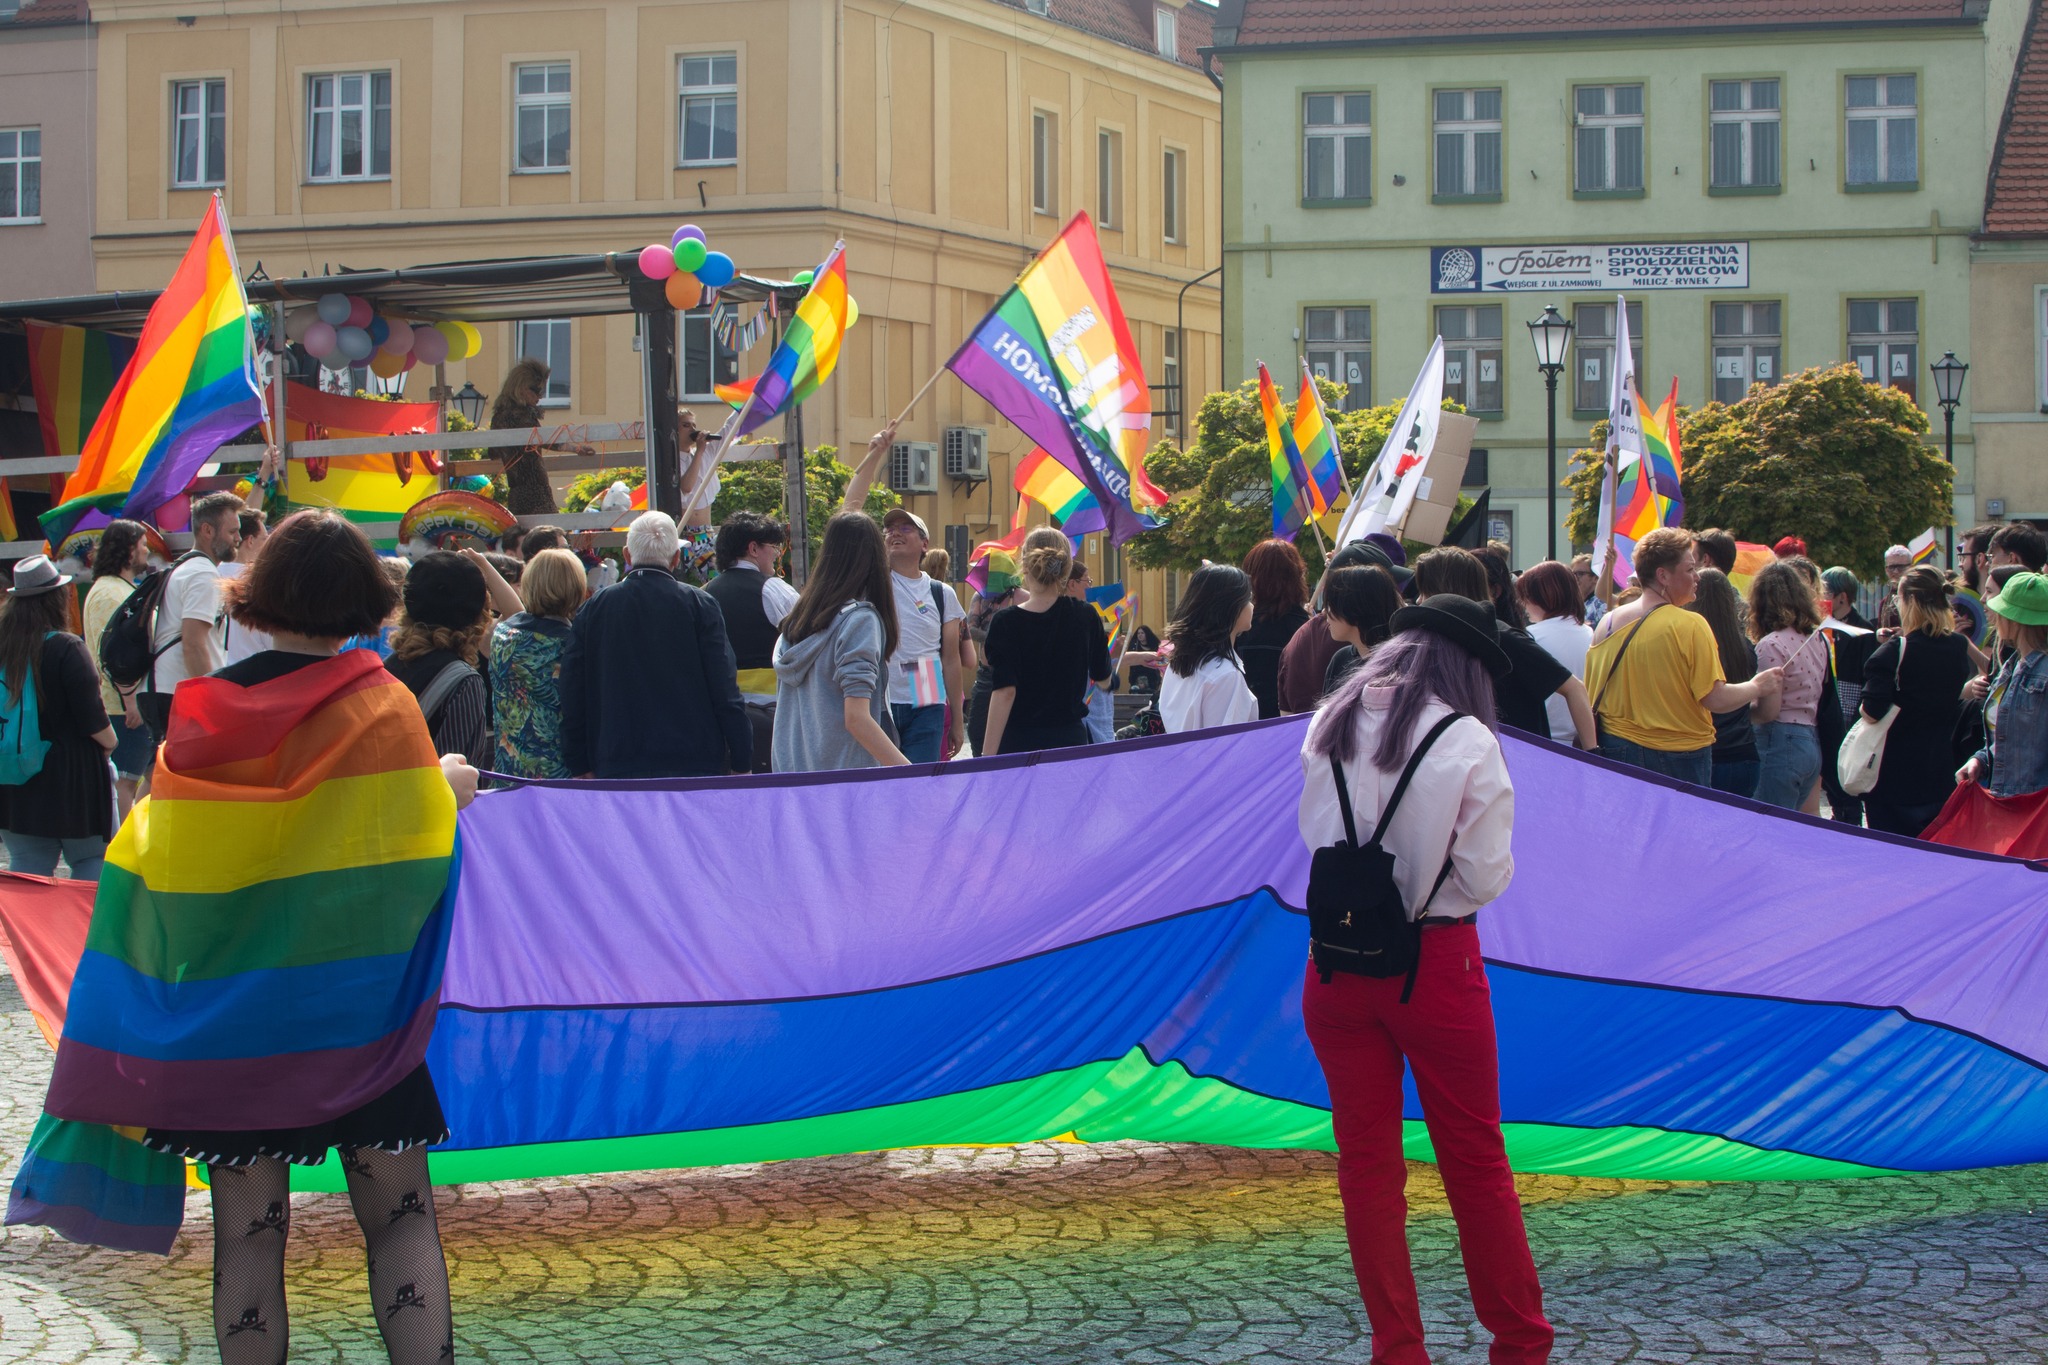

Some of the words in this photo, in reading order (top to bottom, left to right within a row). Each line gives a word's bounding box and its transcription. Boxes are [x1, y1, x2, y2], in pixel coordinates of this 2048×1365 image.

[1608, 245, 1739, 257] POWSZECHNA
[1608, 255, 1739, 267] SPÓŁDZIELNIA
[1608, 265, 1740, 277] SPOŻYWCÓW
[1507, 279, 1539, 289] WEJŚCIE
[1541, 280, 1547, 288] Z
[1632, 277, 1668, 286] MILICZ
[1675, 276, 1710, 285] RYNEK
[1714, 277, 1721, 285] 7
